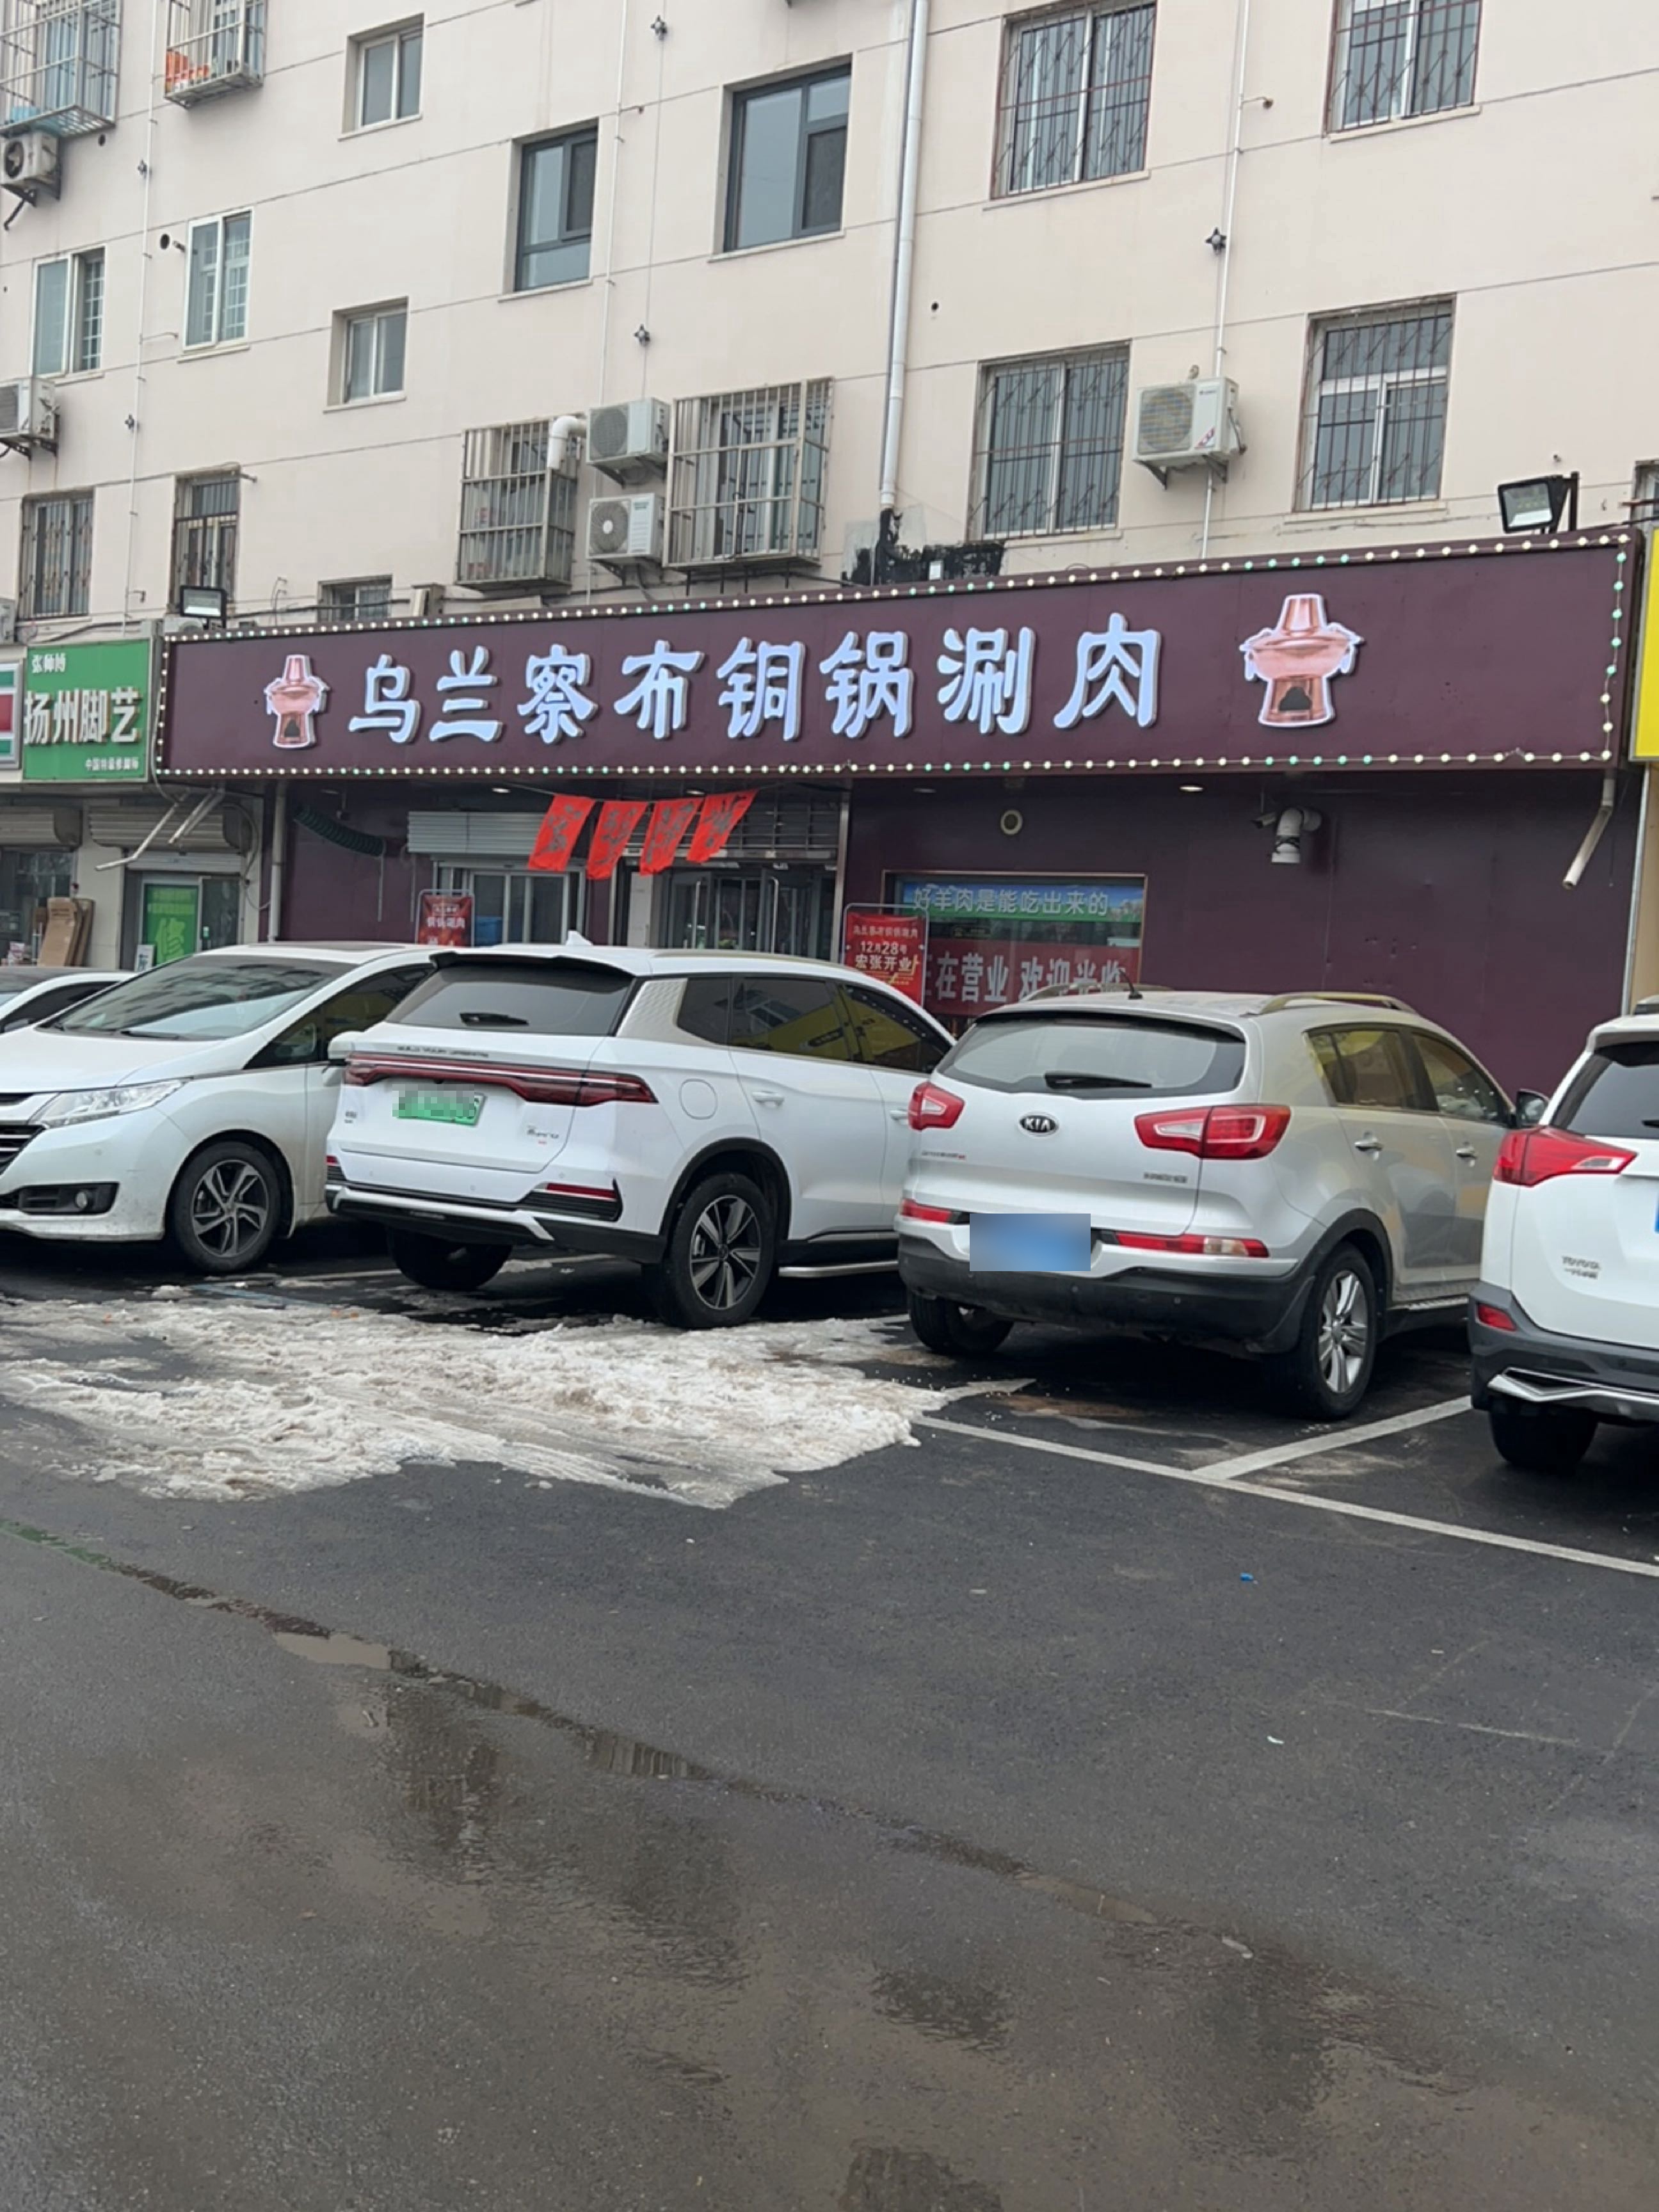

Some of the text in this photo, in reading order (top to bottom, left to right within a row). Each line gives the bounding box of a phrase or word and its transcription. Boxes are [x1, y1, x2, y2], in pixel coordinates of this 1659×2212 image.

[348, 613, 1161, 744] 乌兰察布铜锅涮肉
[24, 687, 140, 744] 扬州脚艺
[913, 888, 1109, 916] 好羊肉是能吃出来的
[1025, 1118, 1051, 1131] KIA
